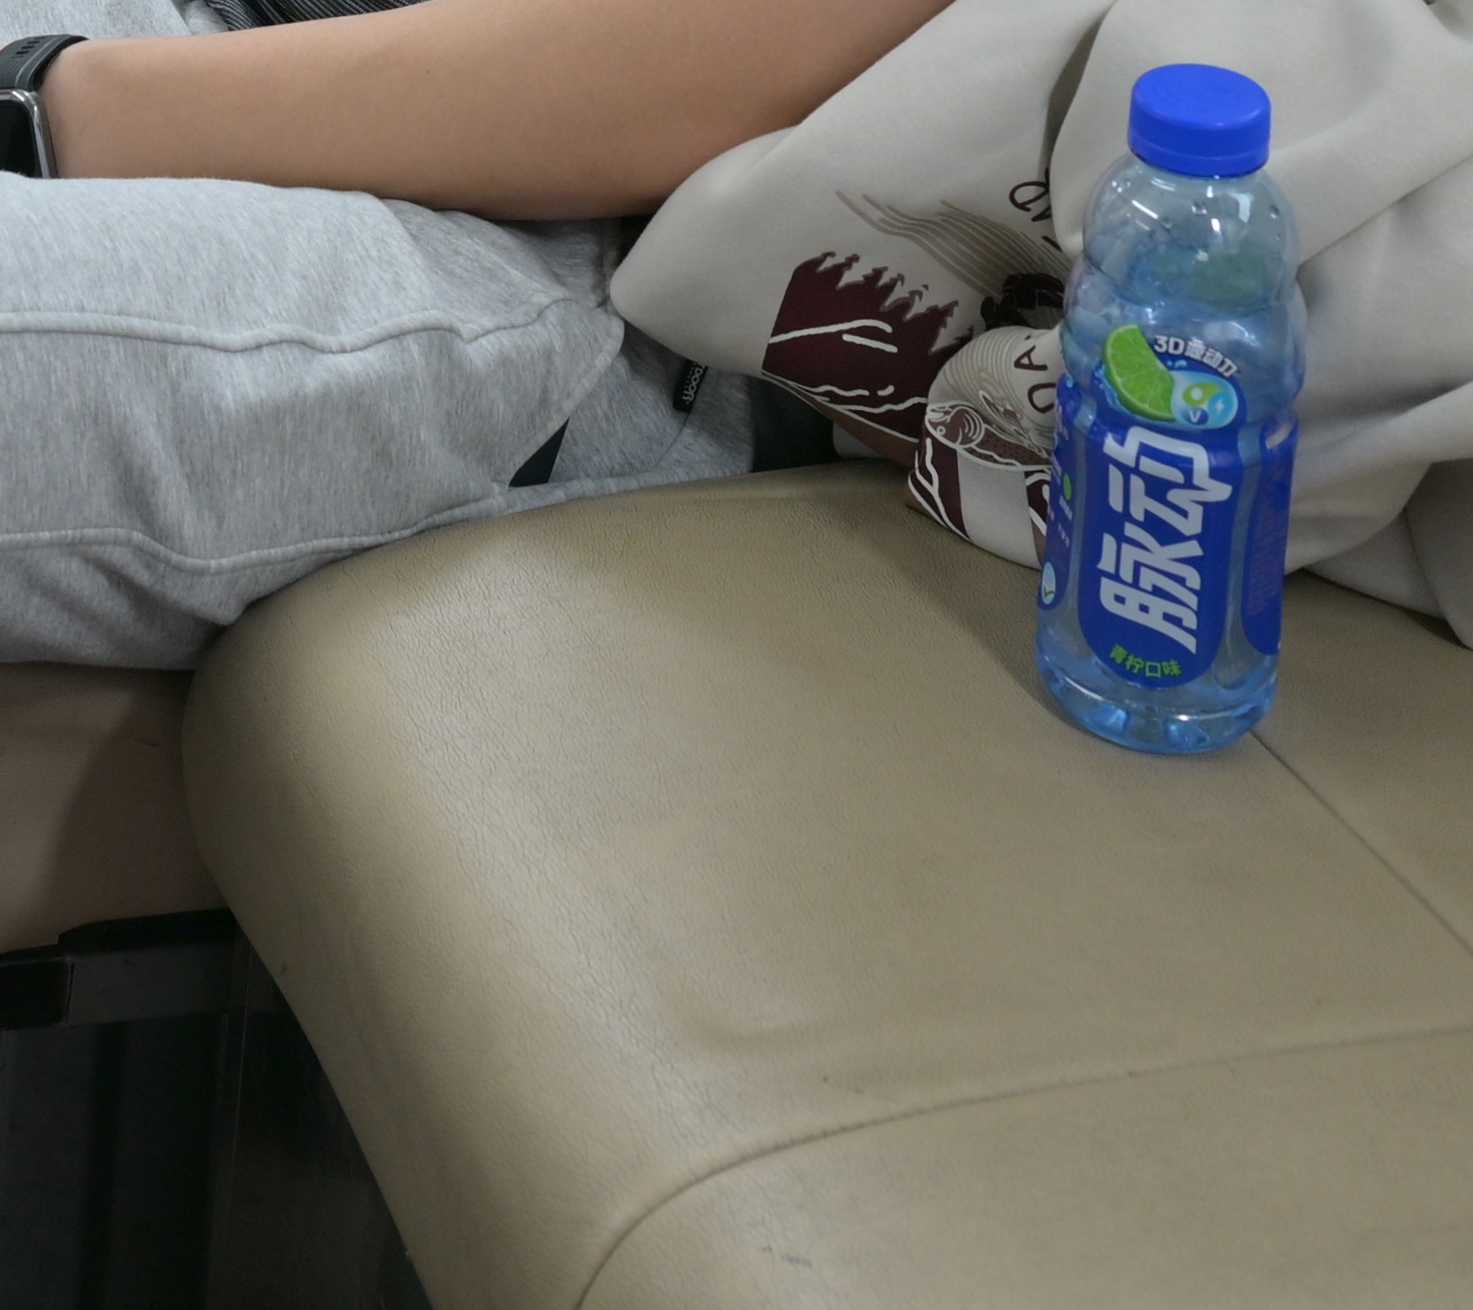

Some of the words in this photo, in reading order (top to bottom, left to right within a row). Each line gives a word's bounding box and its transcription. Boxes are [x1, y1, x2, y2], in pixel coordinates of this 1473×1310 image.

[1098, 425, 1233, 655] 脉动
[1109, 643, 1183, 678] 青柠口味
